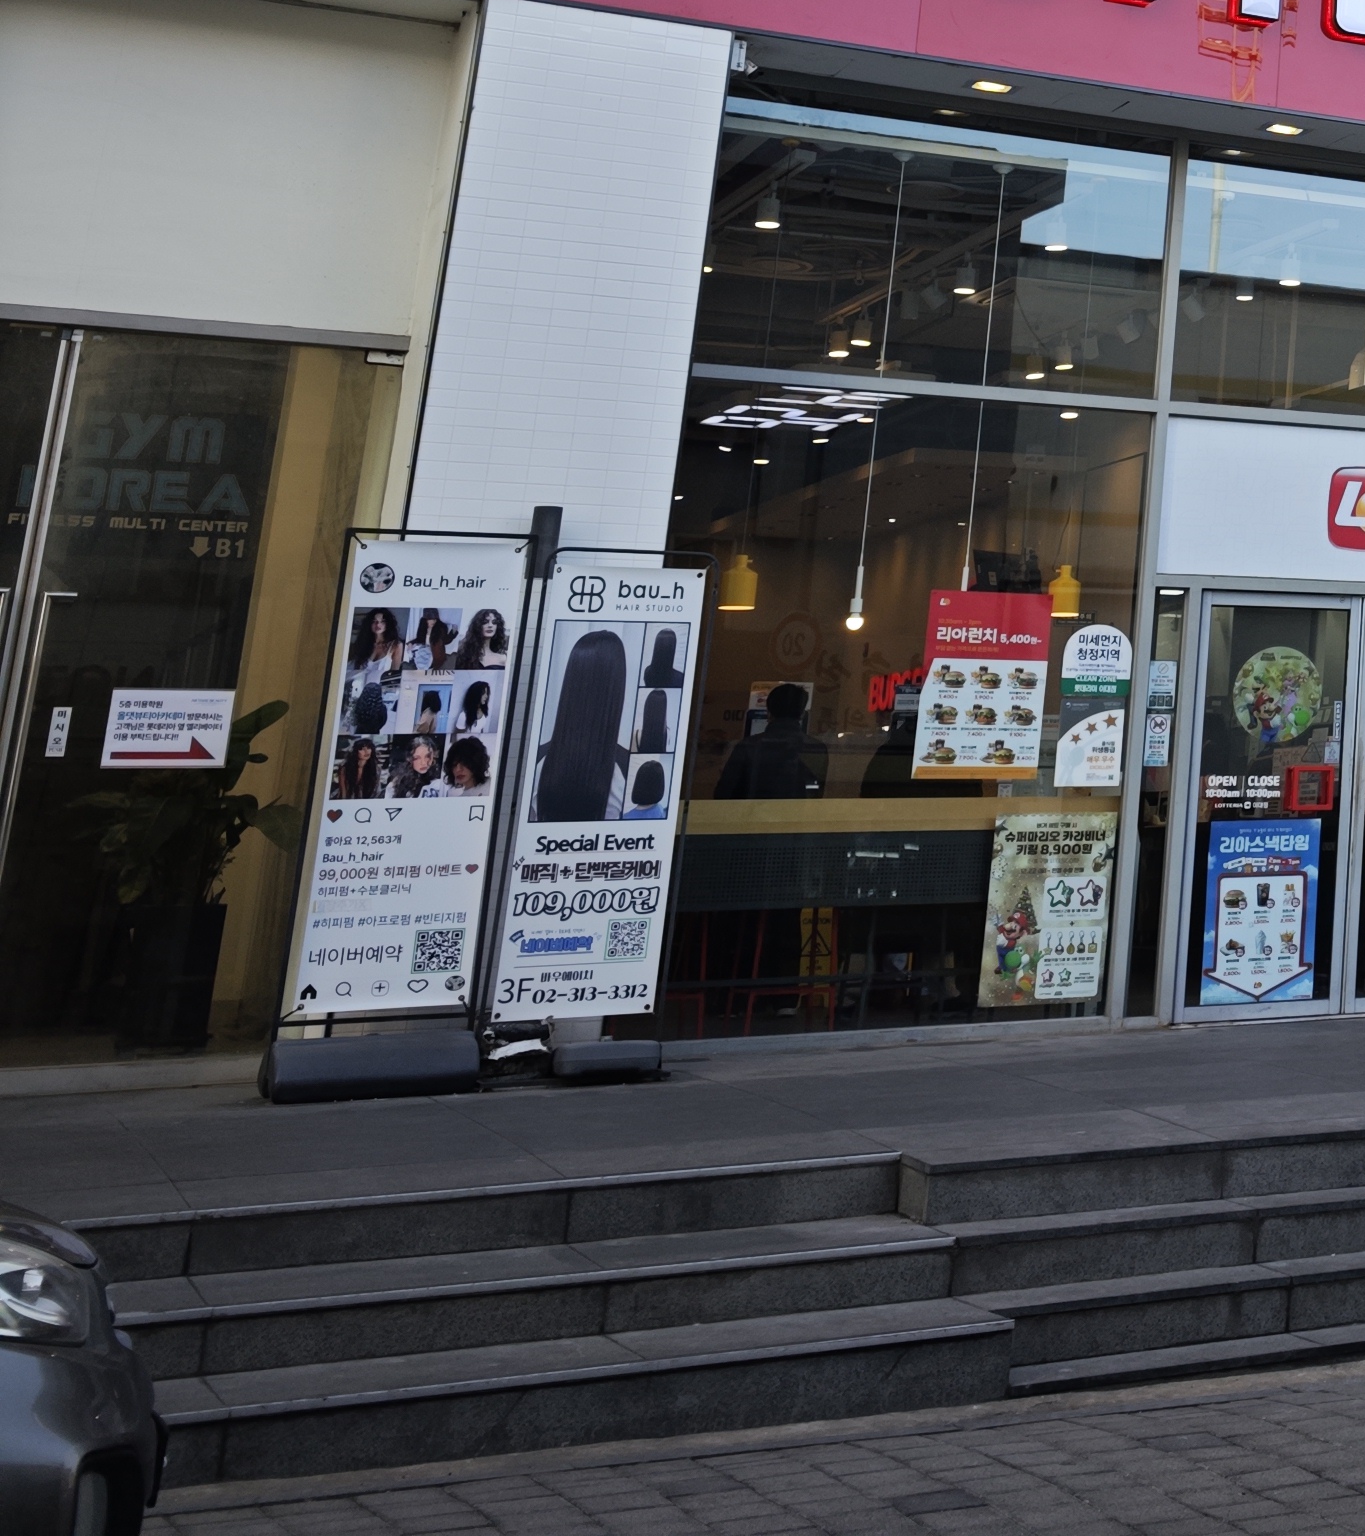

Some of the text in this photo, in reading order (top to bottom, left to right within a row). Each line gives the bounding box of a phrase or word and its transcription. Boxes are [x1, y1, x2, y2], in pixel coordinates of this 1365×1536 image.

[109, 517, 248, 533] MULTI CENTER
[215, 538, 245, 558] B1
[403, 572, 487, 591] Bau_h_hair
[618, 580, 684, 599] bau_h
[616, 603, 683, 613] HAIR STUDIO
[936, 627, 997, 644] 리아런치
[1079, 634, 1121, 647] 미세먼지
[1077, 649, 1120, 661] 청정지역
[52, 710, 67, 745] 미시오
[1208, 776, 1280, 786] OPEN CLOSE
[1205, 789, 1280, 798] 10:00am 10:00pm
[325, 835, 402, 846] 좋아요 12,563개
[536, 833, 655, 854] Special Event
[1004, 830, 1105, 842] 슈퍼마리오 카라비너
[1219, 834, 1309, 853] 리아스낵타임
[322, 851, 384, 863] Bau_h_hair
[1016, 844, 1092, 855] 키링 8,900원
[319, 864, 462, 882] 99,000원 히피펌 이벤트
[318, 884, 411, 897] 히피펌+수분클리닉
[512, 887, 660, 920] 109,000원
[312, 912, 467, 929] #히피펌 #아프로펌 #빈티지펌
[308, 943, 404, 967] 네이버예약
[541, 970, 593, 982] 바우에이치
[498, 977, 648, 1004] 3F 02-313-3312
